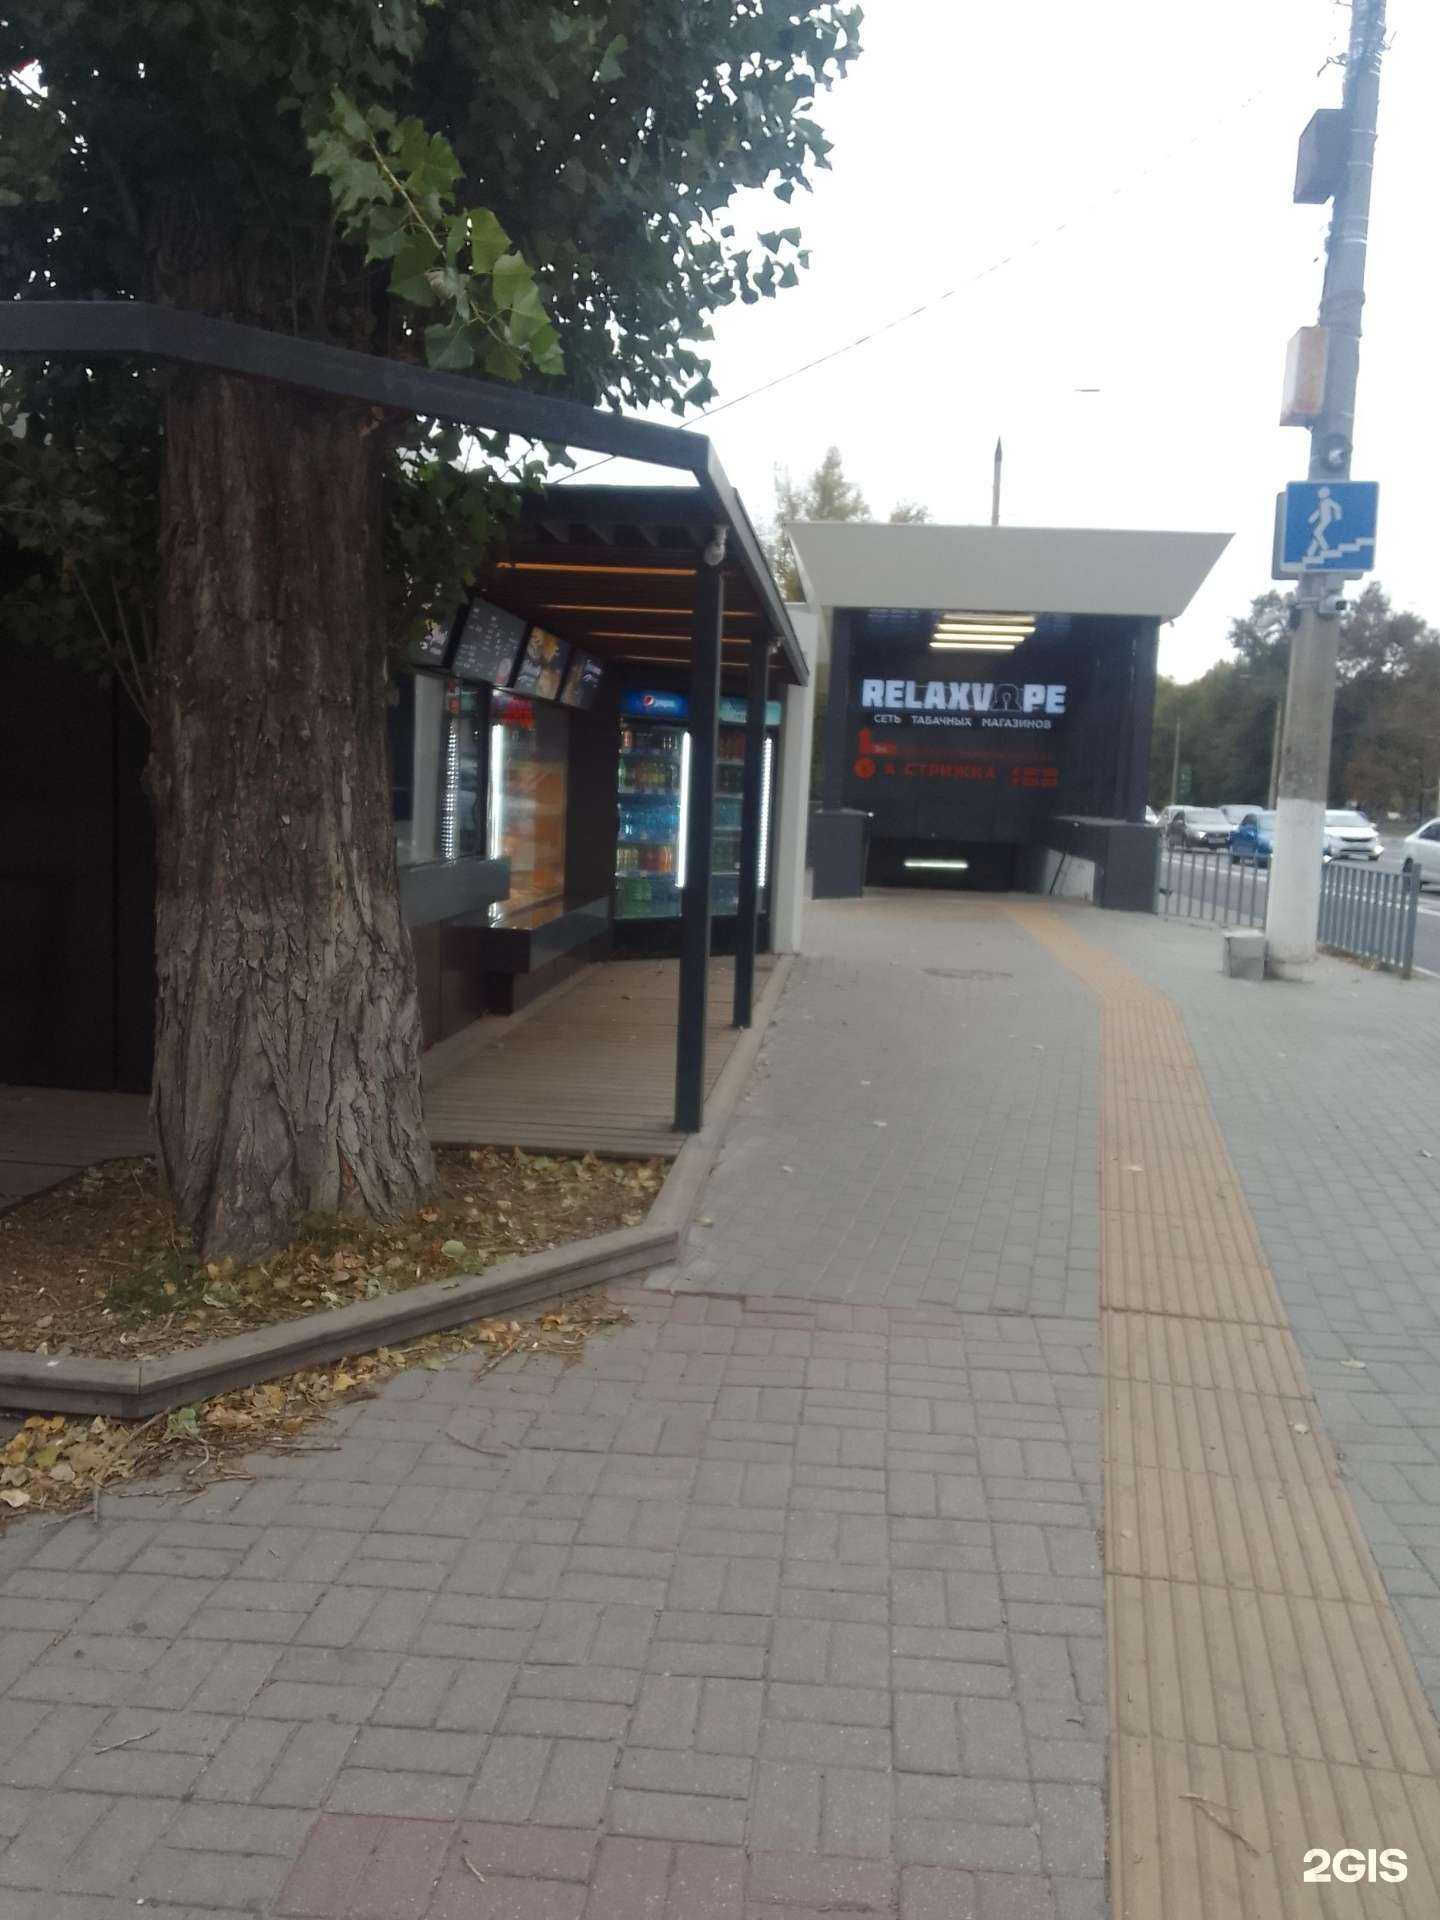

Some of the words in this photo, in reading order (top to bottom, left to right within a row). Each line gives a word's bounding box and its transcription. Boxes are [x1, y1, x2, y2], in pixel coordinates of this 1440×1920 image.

[873, 714, 903, 725] СЕТЬ
[911, 715, 972, 728] ТАБАЧНЫХ
[981, 717, 1053, 730] МАГАЗИНОВ
